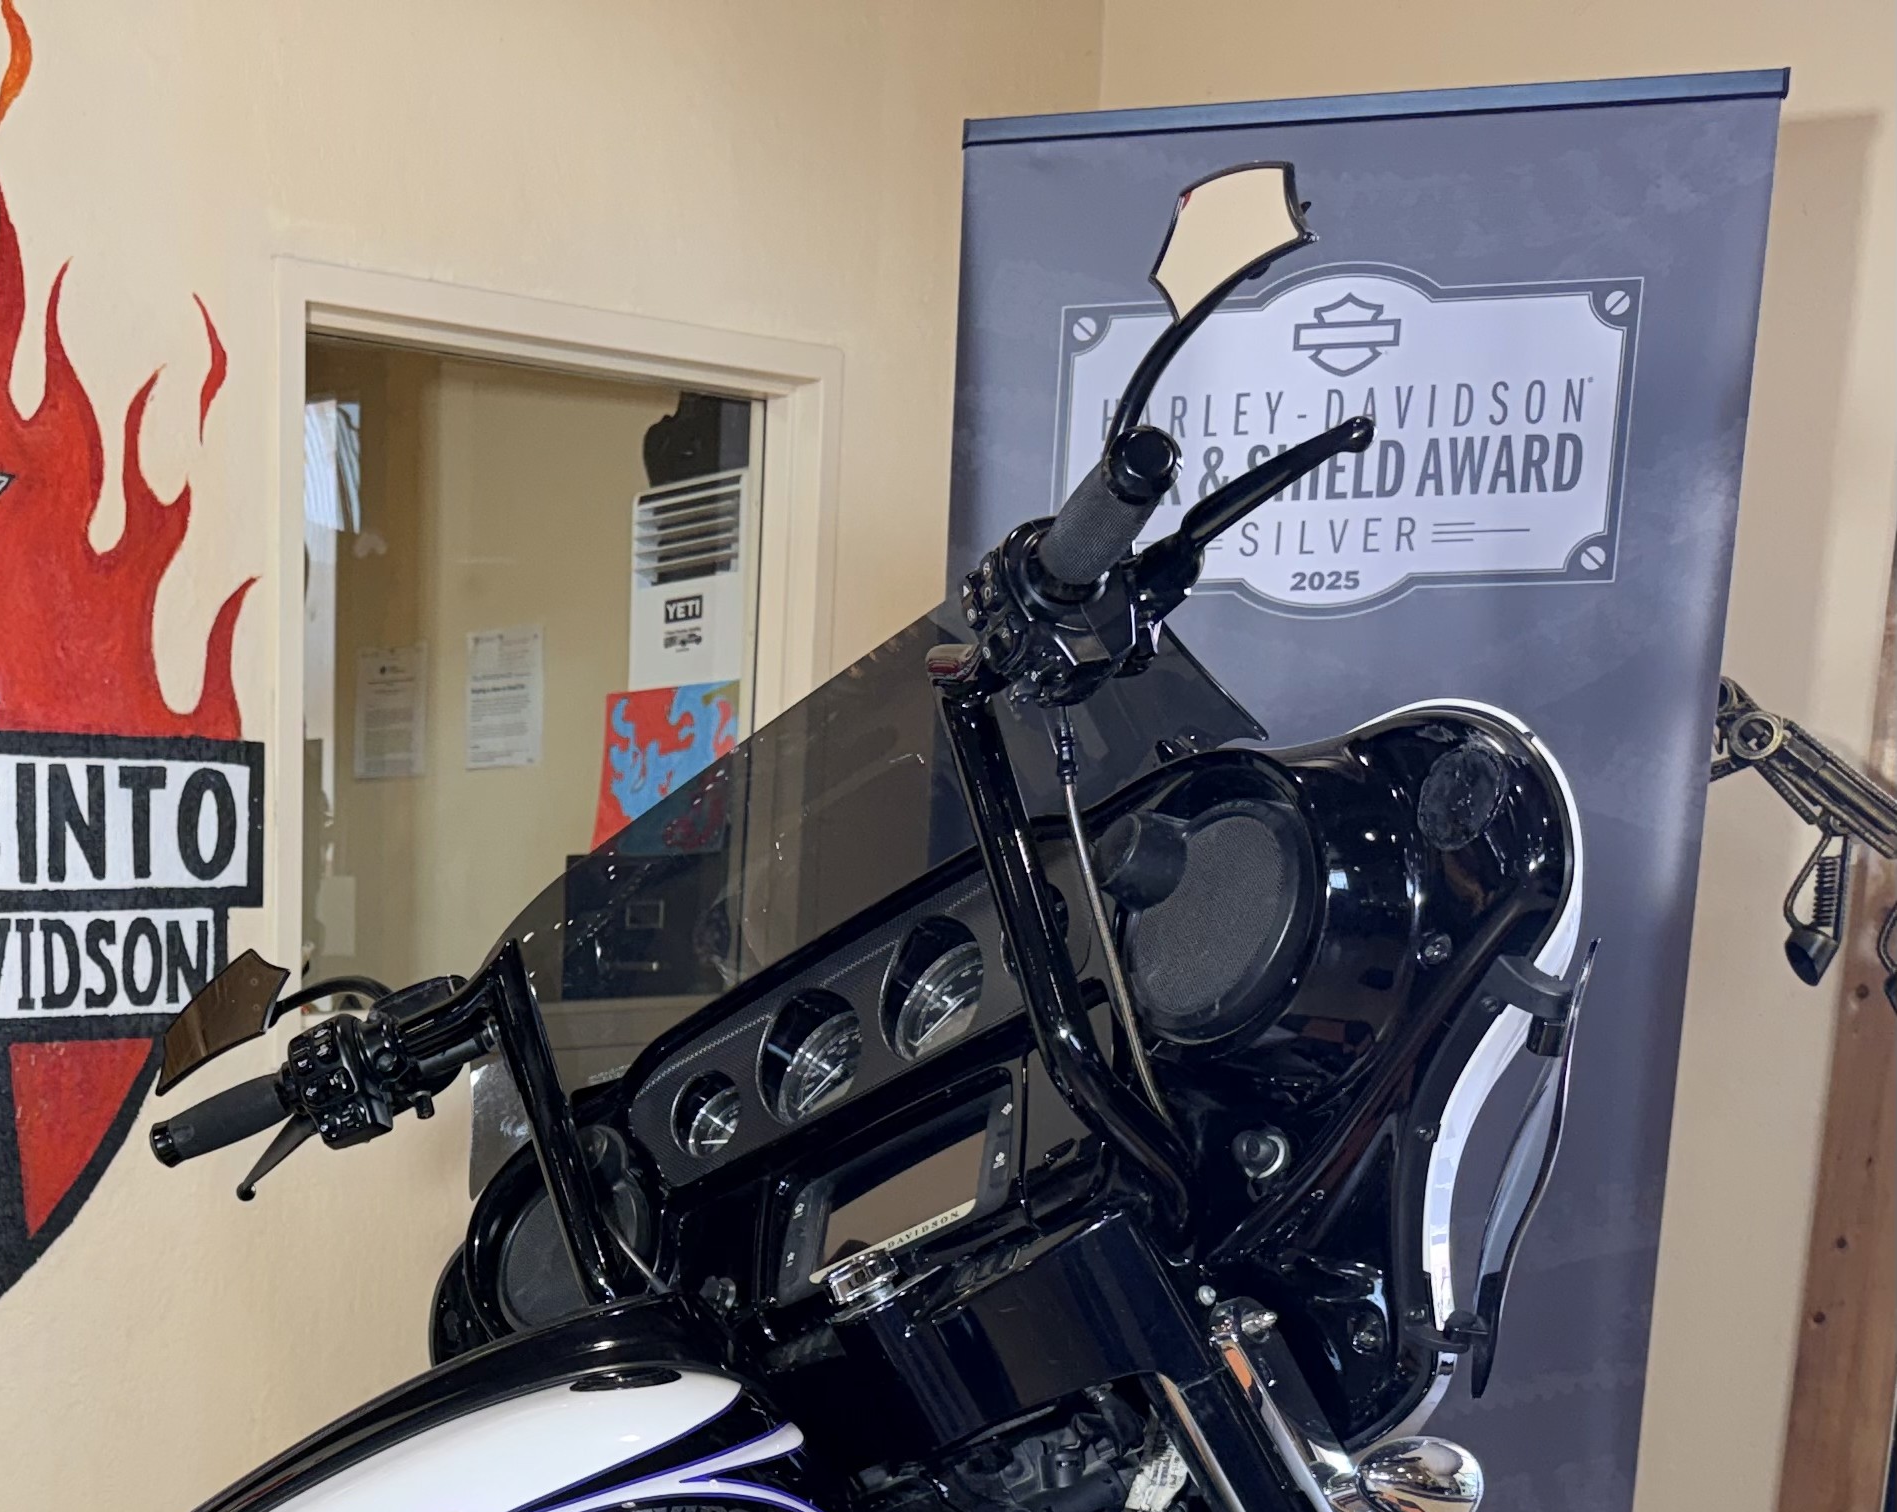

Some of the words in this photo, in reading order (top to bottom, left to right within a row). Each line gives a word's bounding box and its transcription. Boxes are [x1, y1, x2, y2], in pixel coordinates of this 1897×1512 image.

[1198, 446, 1229, 500] &
[1415, 433, 1583, 497] AWARD
[1239, 516, 1416, 557] SILVER
[1290, 570, 1360, 592] 2025
[666, 599, 701, 620] YETI
[888, 1211, 960, 1248] DAVIDSON
